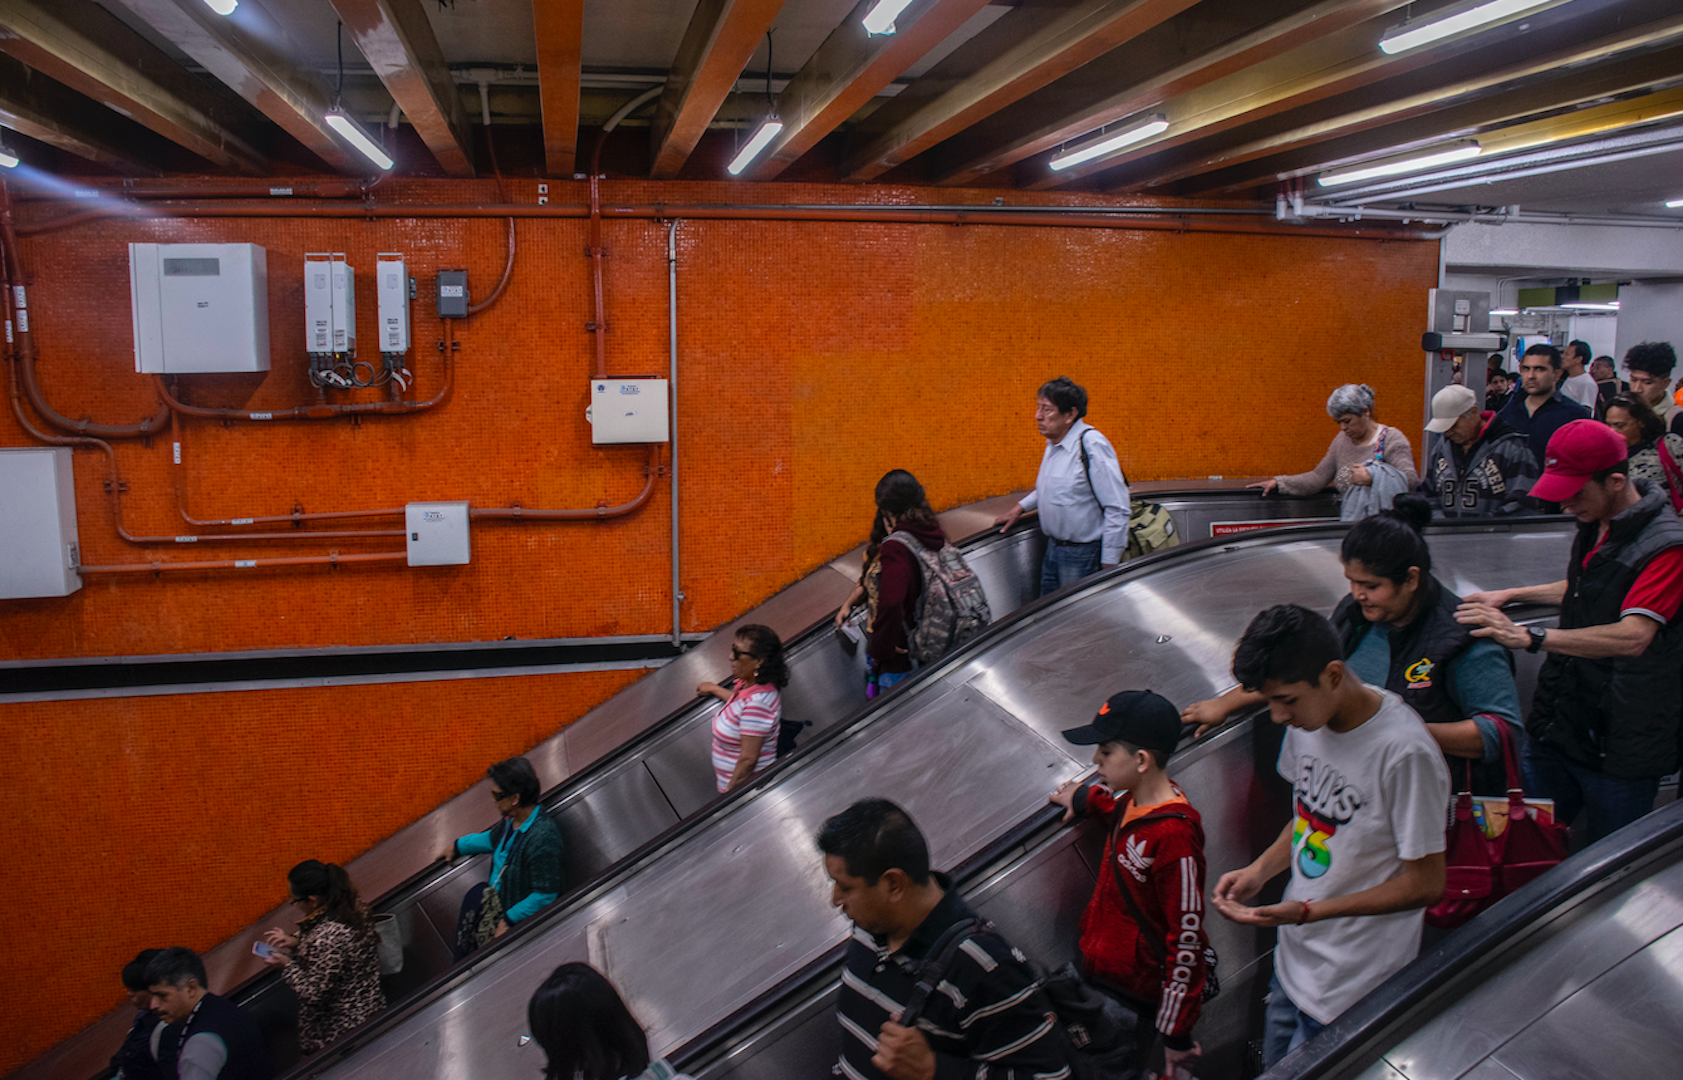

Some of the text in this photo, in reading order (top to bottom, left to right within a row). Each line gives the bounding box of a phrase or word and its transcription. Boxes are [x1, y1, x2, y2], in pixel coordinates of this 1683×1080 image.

[1442, 477, 1480, 510] 85
[1117, 853, 1147, 883] adidas
[1169, 913, 1201, 994] adidas
